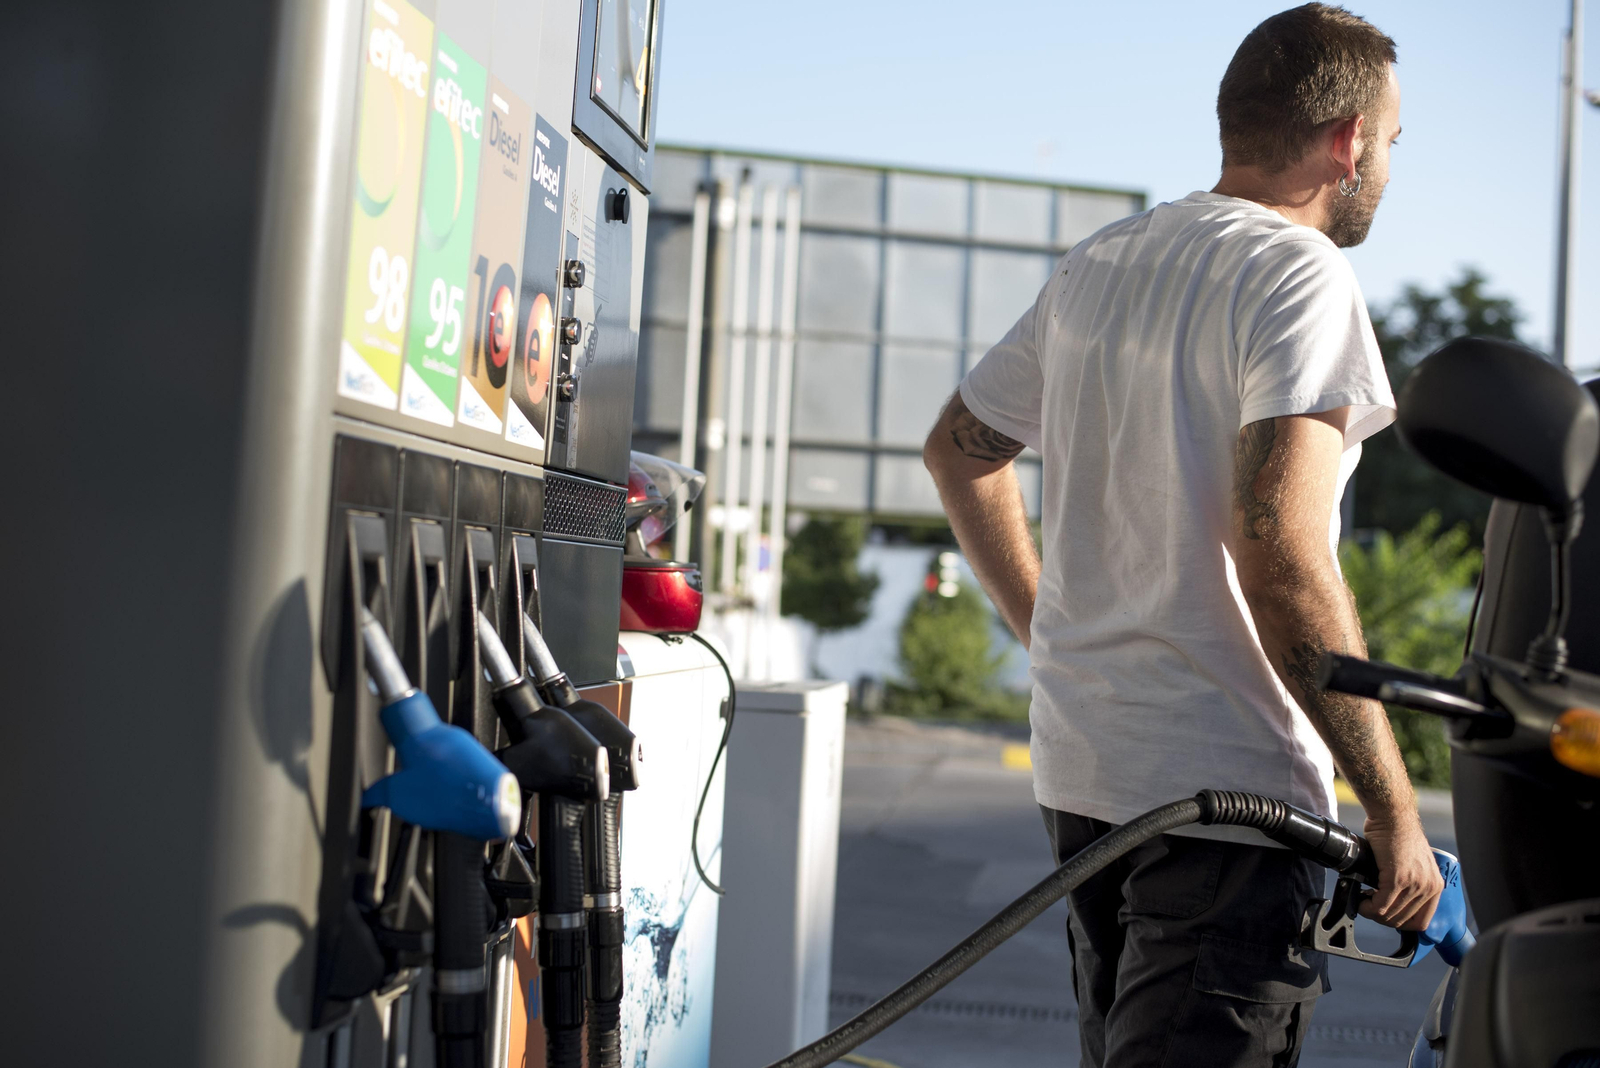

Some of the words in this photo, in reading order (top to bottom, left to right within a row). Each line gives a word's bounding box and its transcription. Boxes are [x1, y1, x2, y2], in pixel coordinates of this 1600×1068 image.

[489, 110, 521, 166] Diesel
[532, 145, 561, 198] Diesel
[364, 246, 408, 333] 98
[424, 277, 464, 356] 95
